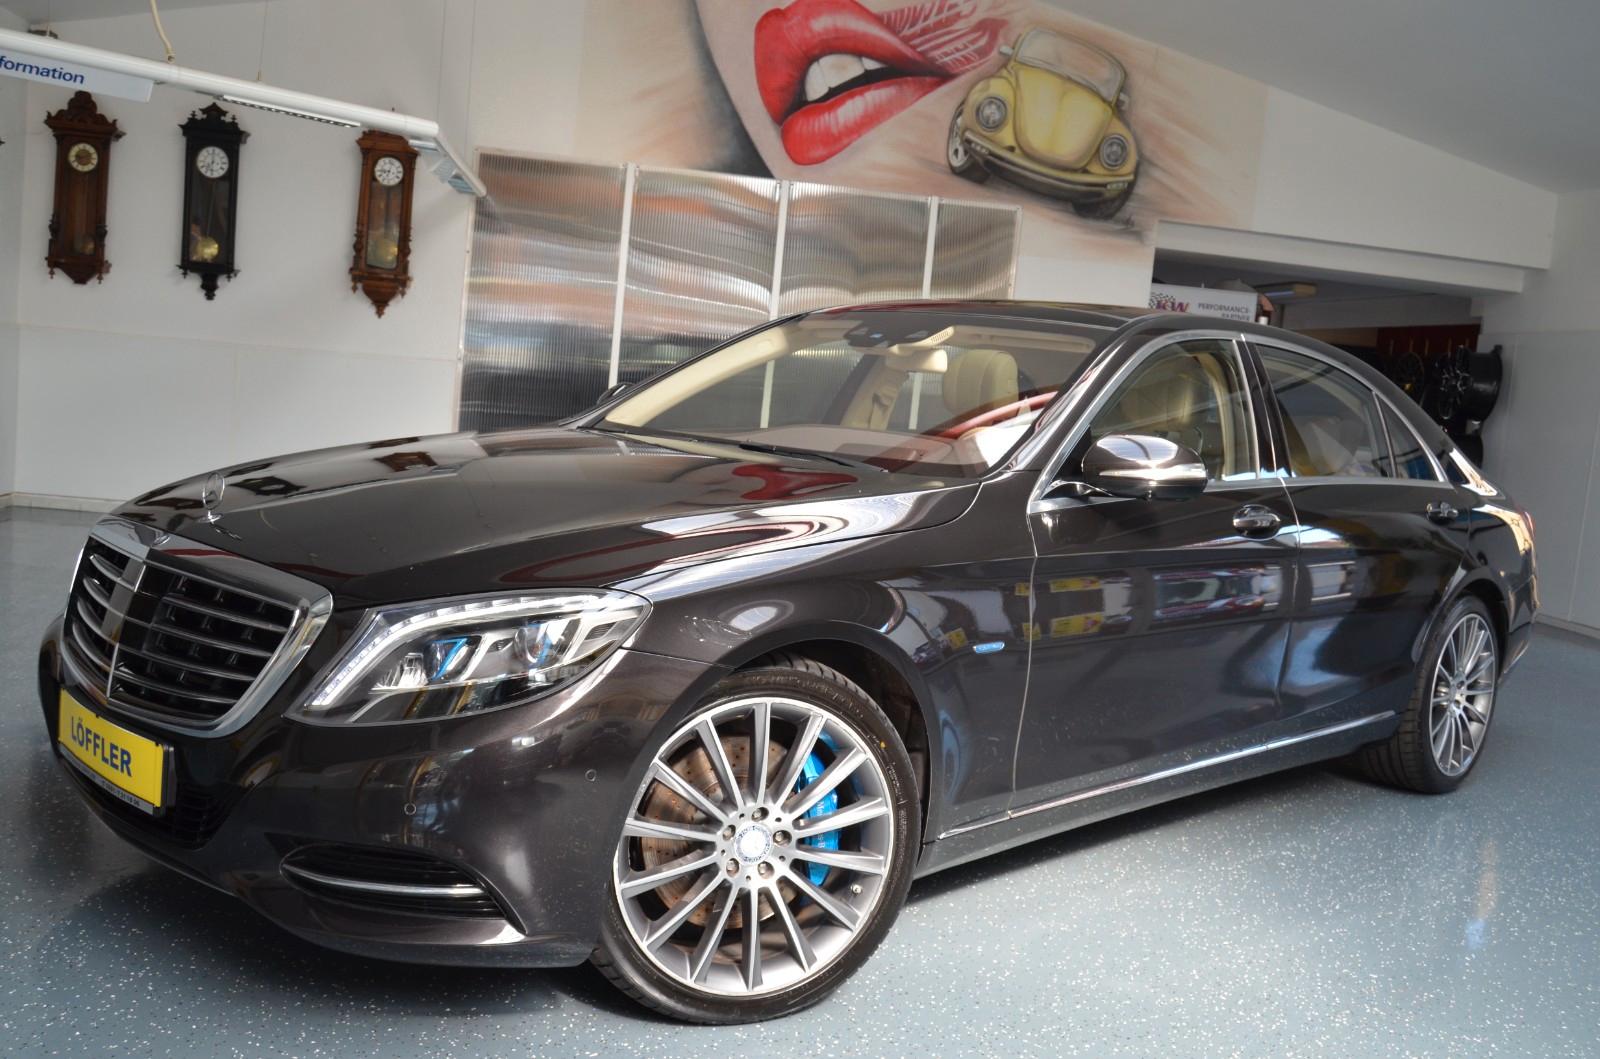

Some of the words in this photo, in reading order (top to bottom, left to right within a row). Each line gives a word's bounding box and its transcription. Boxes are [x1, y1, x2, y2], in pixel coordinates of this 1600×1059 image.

[0, 56, 85, 84] formation
[1198, 302, 1250, 314] PERFORMANCE
[71, 716, 132, 777] LÖFFLER
